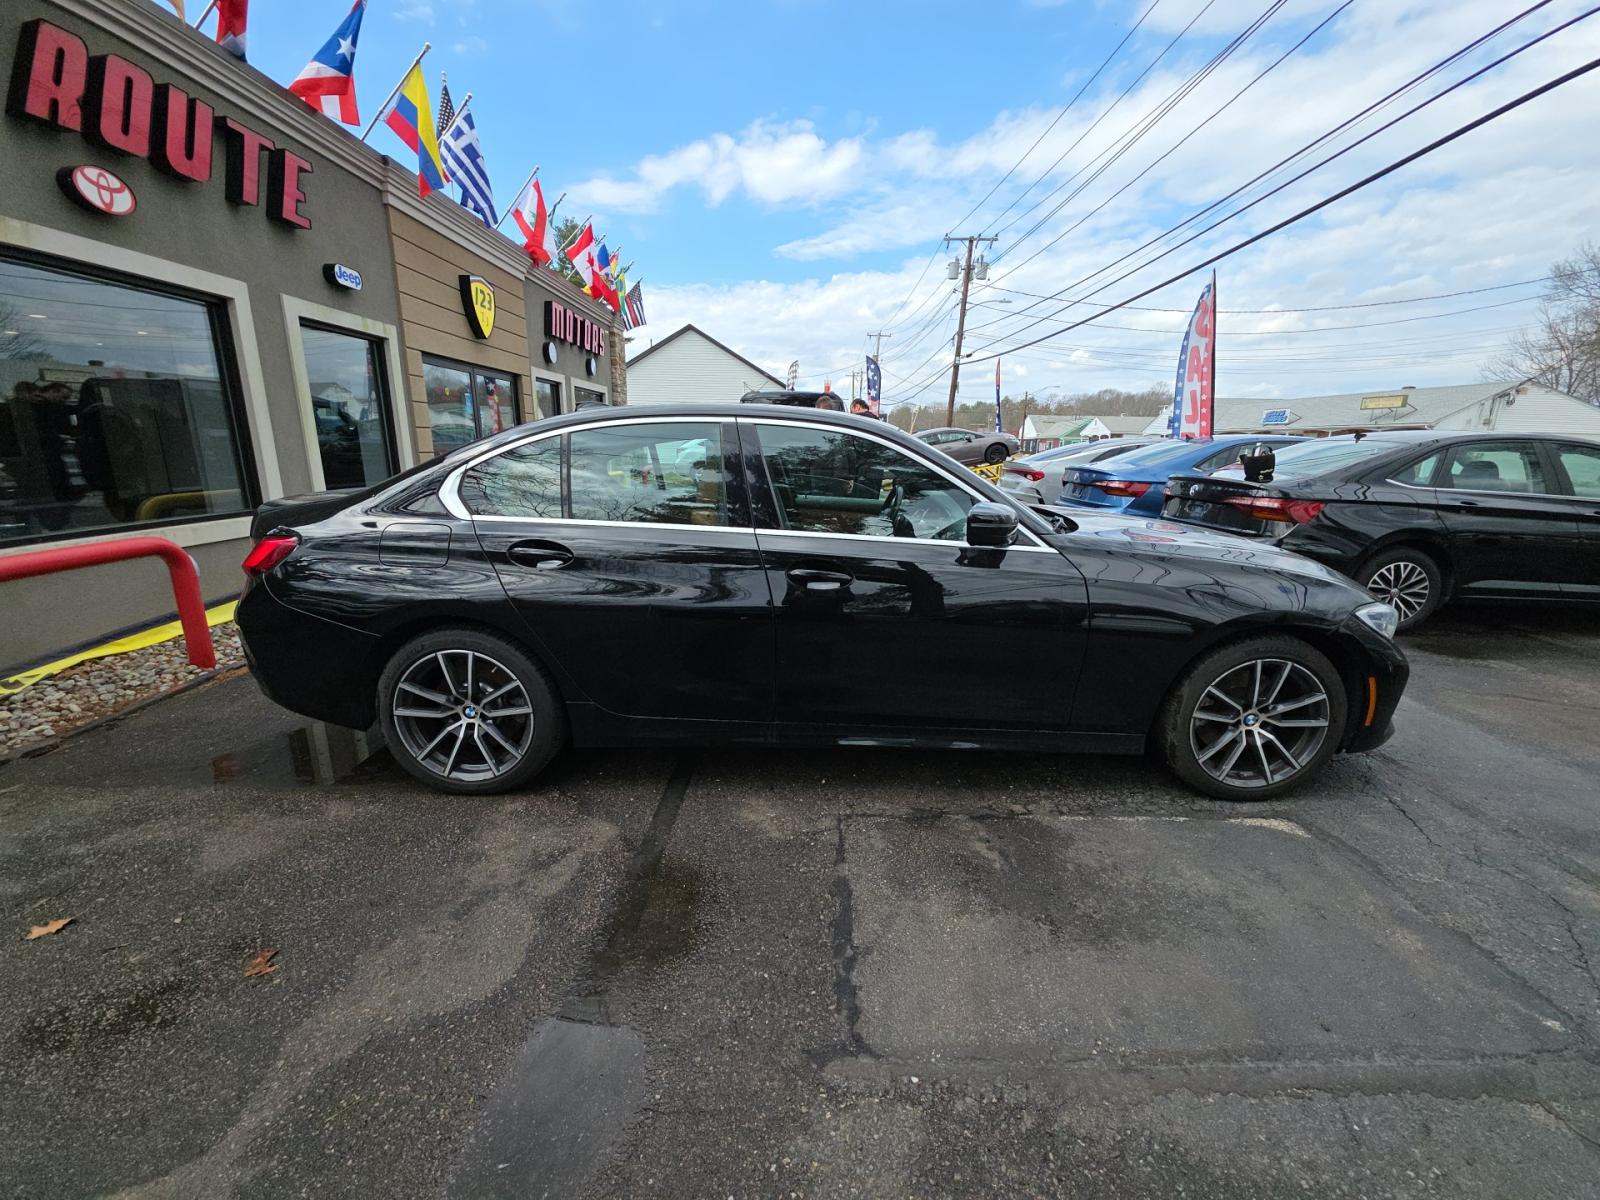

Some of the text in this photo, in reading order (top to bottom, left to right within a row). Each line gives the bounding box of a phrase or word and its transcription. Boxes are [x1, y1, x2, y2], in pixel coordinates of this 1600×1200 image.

[23, 18, 314, 230] ROUTE
[336, 265, 361, 288] Jeep
[475, 286, 493, 311] 123
[551, 301, 605, 357] MOTORS
